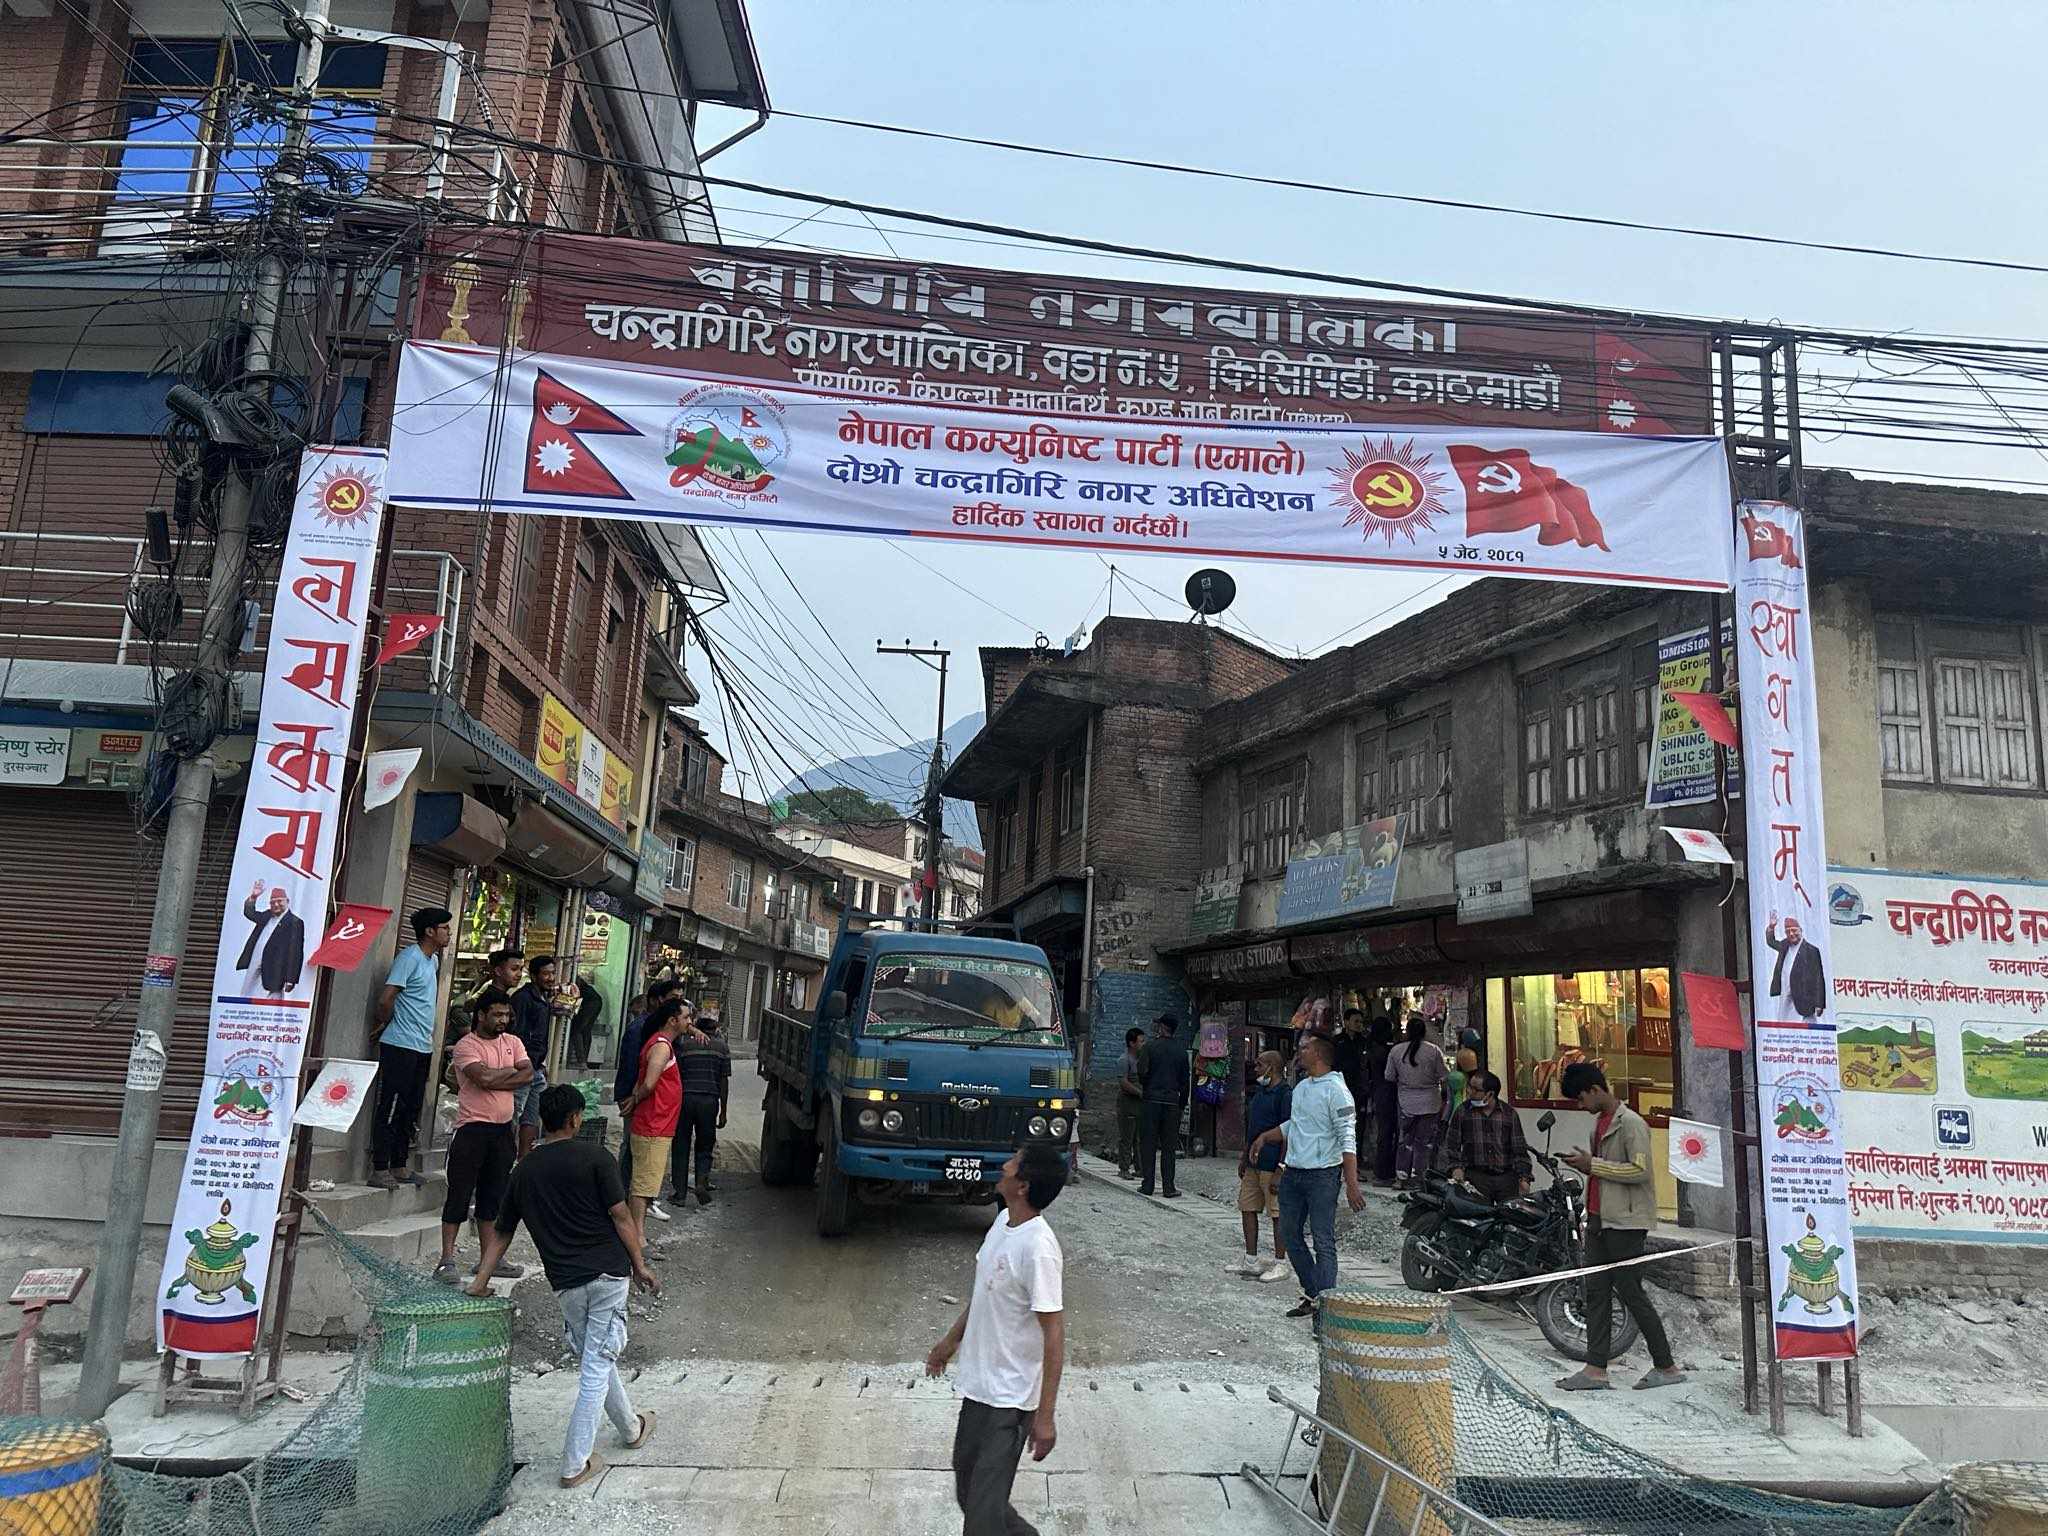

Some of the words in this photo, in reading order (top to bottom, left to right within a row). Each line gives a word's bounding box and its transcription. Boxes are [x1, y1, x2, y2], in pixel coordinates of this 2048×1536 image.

[585, 301, 776, 356] चन्द्रागिरि
[1041, 342, 1113, 384] वडा
[838, 410, 935, 451] नेपाल
[945, 423, 1105, 464] कम्युनिष्ट
[1114, 433, 1183, 467] पार्टी
[1195, 441, 1305, 476] (एमाले)
[826, 455, 904, 485] दोश्रो
[914, 467, 1068, 500] चन्द्रागिरि
[1078, 480, 1157, 506] नगर
[1168, 480, 1316, 512] अधिवेशन
[952, 501, 1026, 528] हार्दिक
[1033, 510, 1106, 533] स्वागत
[1438, 545, 1448, 559] ५
[1487, 548, 1524, 562] २०८१
[1660, 674, 1697, 690] ursery
[34, 736, 67, 756] स्टोर
[1661, 732, 1706, 752] SHINING
[1661, 751, 1695, 767] UBLIC
[1886, 888, 2014, 945] चन्द्रागिरि
[1246, 945, 1284, 967] STUDIO
